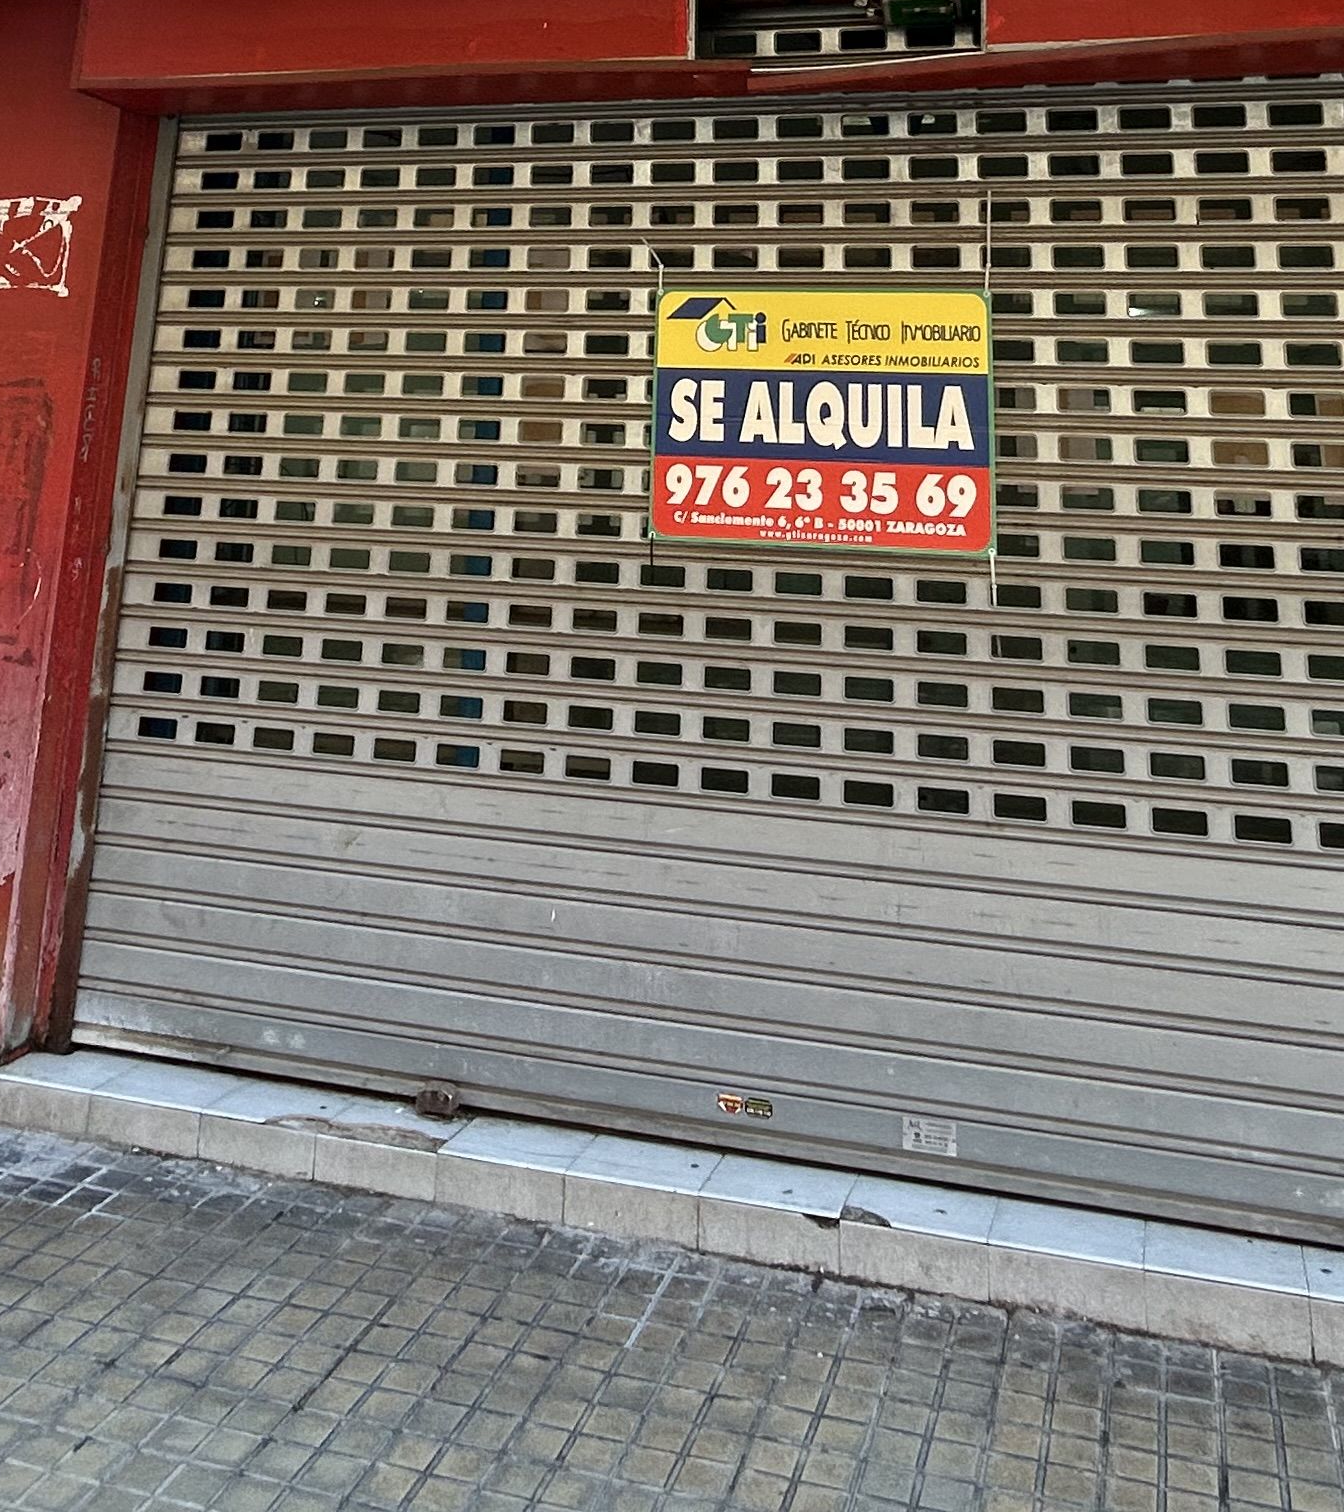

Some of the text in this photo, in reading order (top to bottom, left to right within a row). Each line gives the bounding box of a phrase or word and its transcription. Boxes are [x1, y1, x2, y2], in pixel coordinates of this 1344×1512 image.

[781, 319, 838, 342] GABINETE
[901, 320, 981, 344] INMOBILIARIO
[821, 354, 882, 366] ASESORES
[884, 355, 980, 368] INMOBILIARIOS
[668, 377, 975, 451] SE ALQUILA
[665, 463, 977, 519] 976 23 35 69
[673, 510, 688, 524] C/
[886, 521, 967, 536] ZARAGOZA
